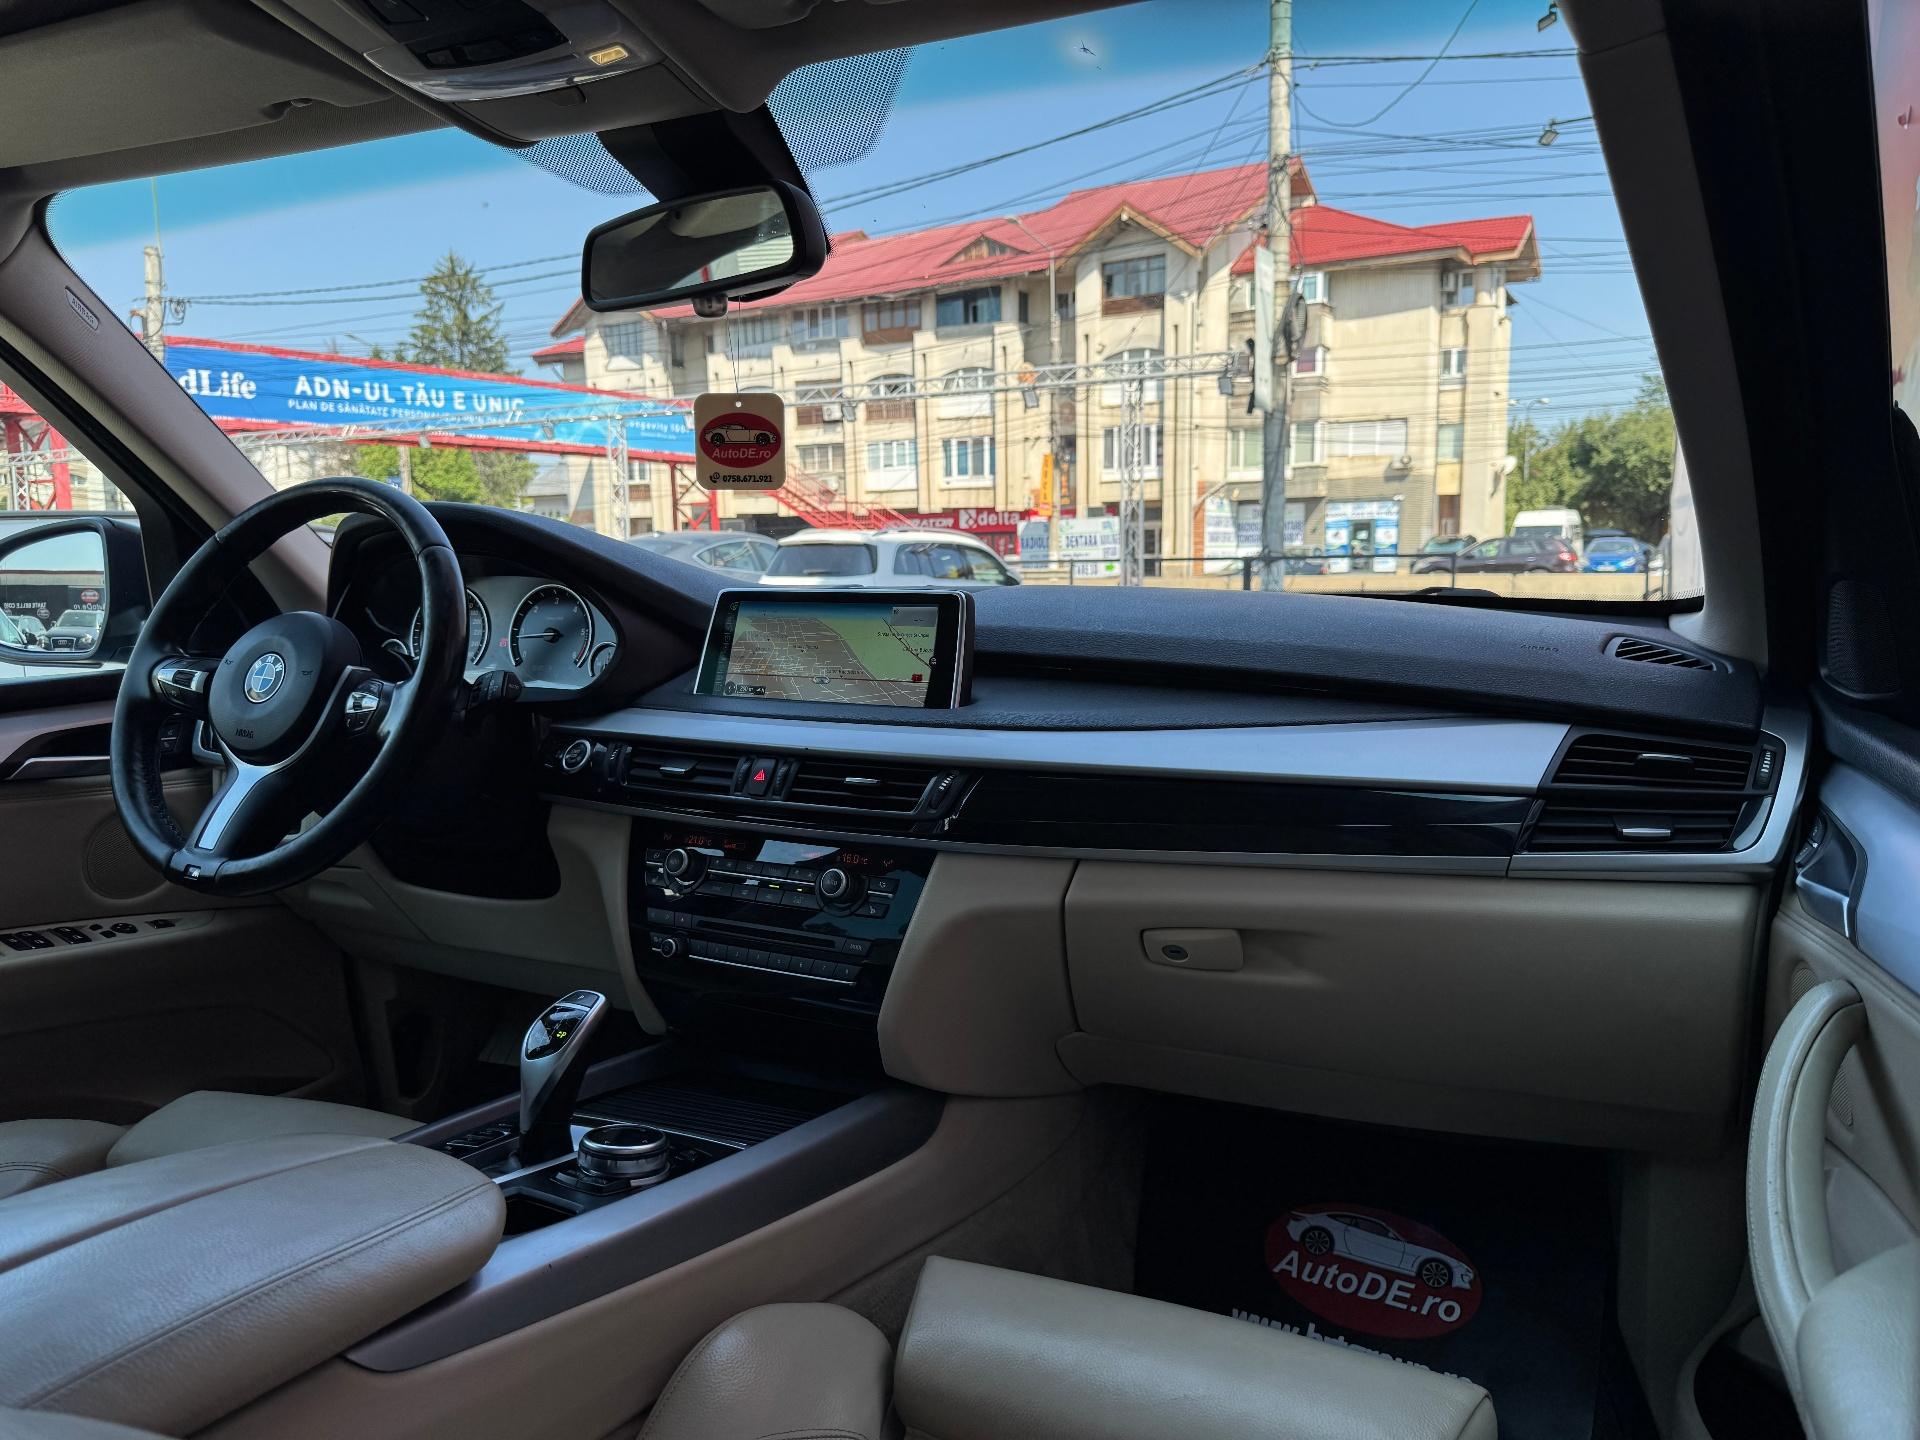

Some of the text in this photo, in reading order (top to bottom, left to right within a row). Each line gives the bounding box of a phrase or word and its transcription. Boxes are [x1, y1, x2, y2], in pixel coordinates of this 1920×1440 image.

[294, 375, 525, 413] ADN-UL TĂU E UNIC
[287, 398, 318, 411] PLAN
[320, 401, 335, 413] DE
[627, 420, 669, 433] ongevity
[712, 448, 771, 459] AutoDE.ro
[977, 511, 1020, 526] delta
[255, 655, 283, 673] BMW
[1273, 1250, 1461, 1322] AutoDE.ro
